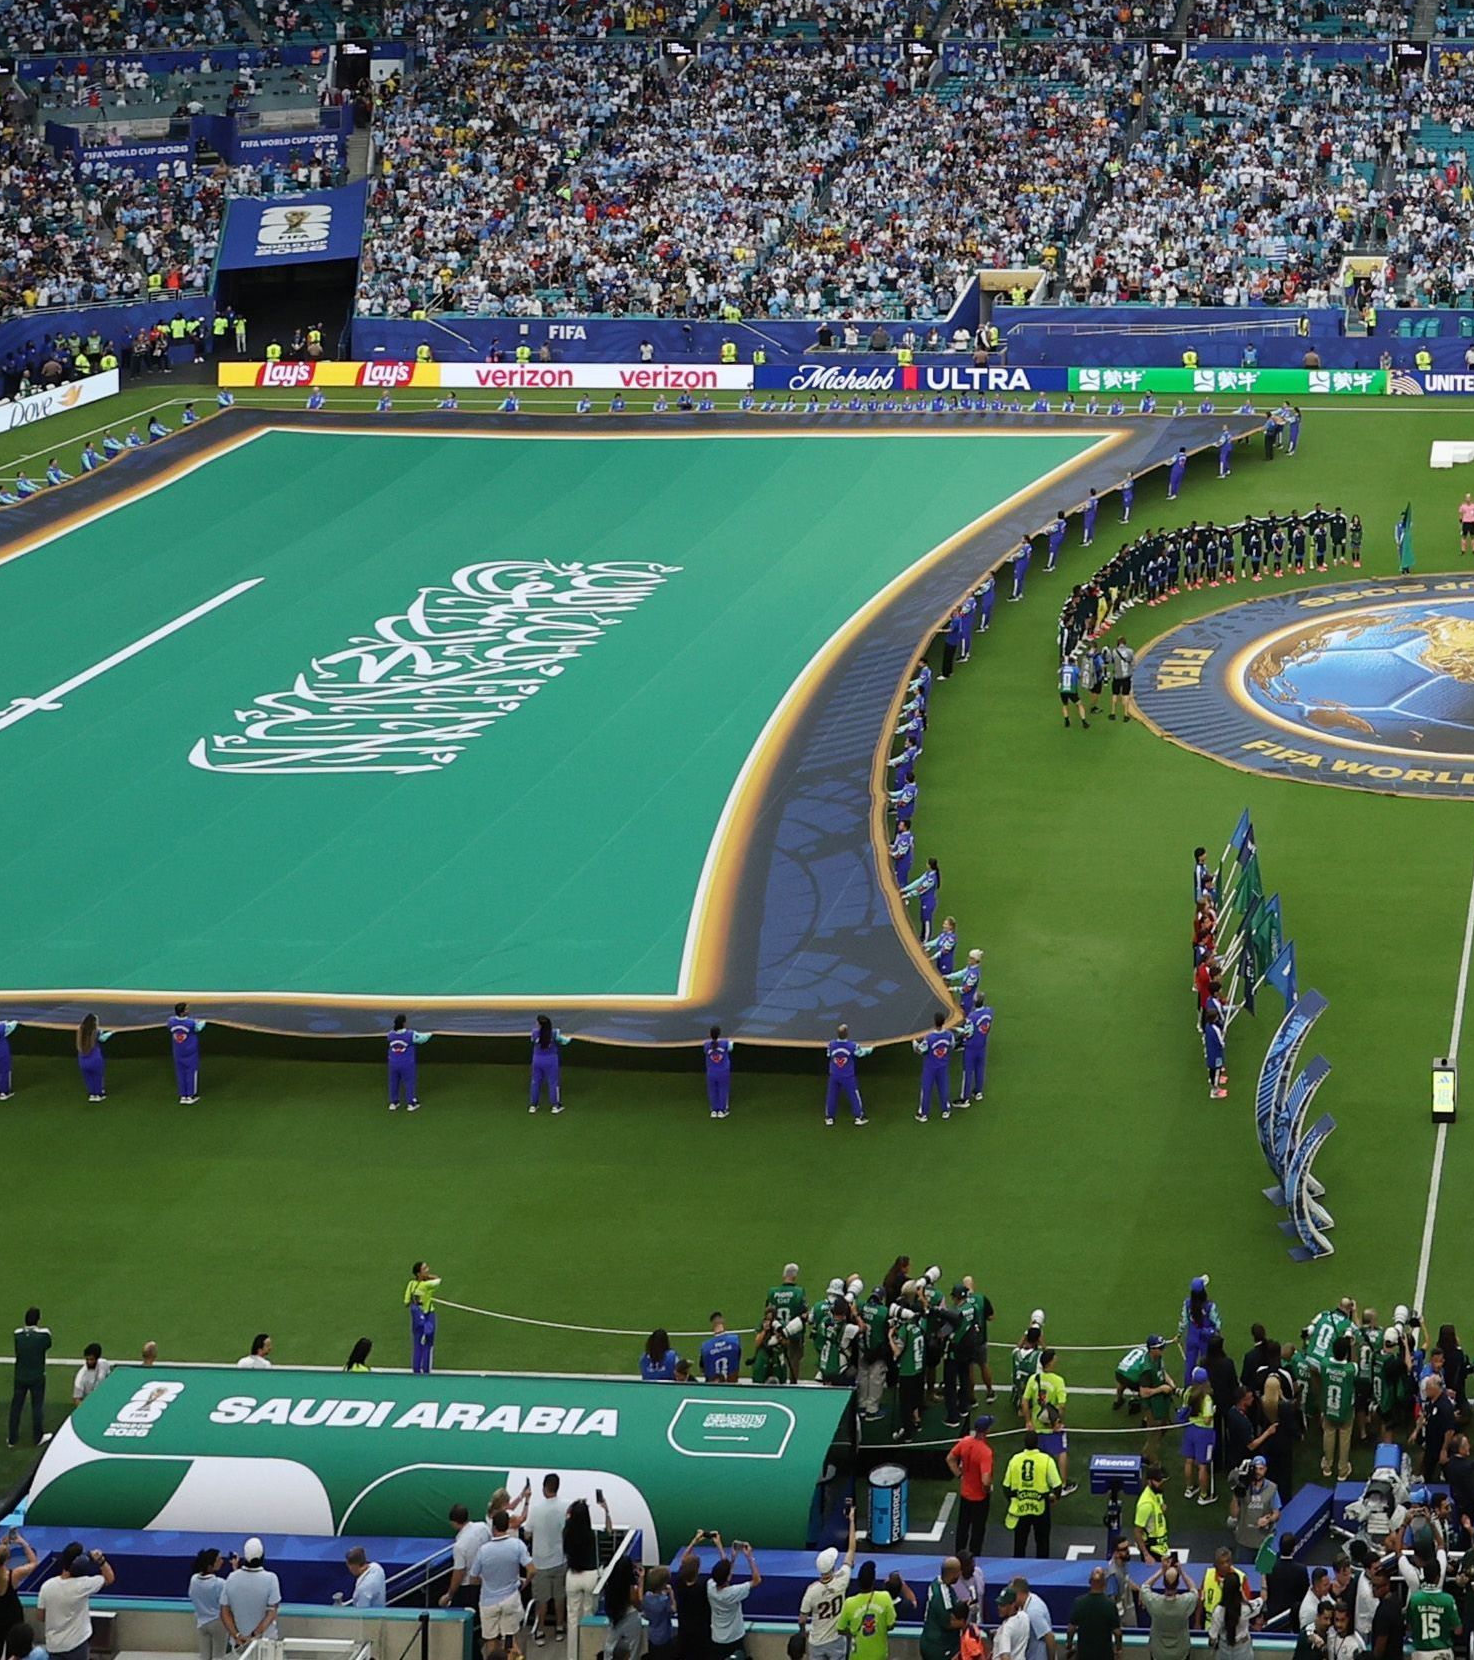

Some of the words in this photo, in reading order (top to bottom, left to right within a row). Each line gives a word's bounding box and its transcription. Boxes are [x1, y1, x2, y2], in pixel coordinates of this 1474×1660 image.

[102, 149, 131, 159] WORLD
[134, 147, 156, 156] CUP
[157, 145, 189, 155] 2026
[240, 139, 259, 149] FIFA
[261, 138, 289, 148] WORLD
[291, 136, 308, 146] CUP
[309, 134, 339, 144] 2026
[549, 324, 587, 339] FIFA
[262, 363, 311, 386] Lay's
[362, 363, 412, 386] Lay's
[475, 366, 573, 388] verizon
[619, 367, 717, 389] verizon
[788, 365, 895, 390] Michelob
[926, 367, 1031, 390] ULTRA
[1103, 368, 1138, 389] 蒙牛
[1218, 369, 1253, 390] 蒙牛
[1333, 370, 1370, 392] 蒙牛
[9, 391, 54, 430] Dove
[1156, 647, 1214, 692] FIFA
[1240, 739, 1323, 769] FIFA
[208, 1395, 386, 1430] SAUDI
[398, 1401, 620, 1437] ARABIA
[103, 1427, 150, 1437] 2026
[1093, 1457, 1137, 1467] Hisense
[892, 1487, 901, 1542] POWERADE
[817, 1594, 843, 1620] 20
[1420, 1612, 1441, 1640] 15
